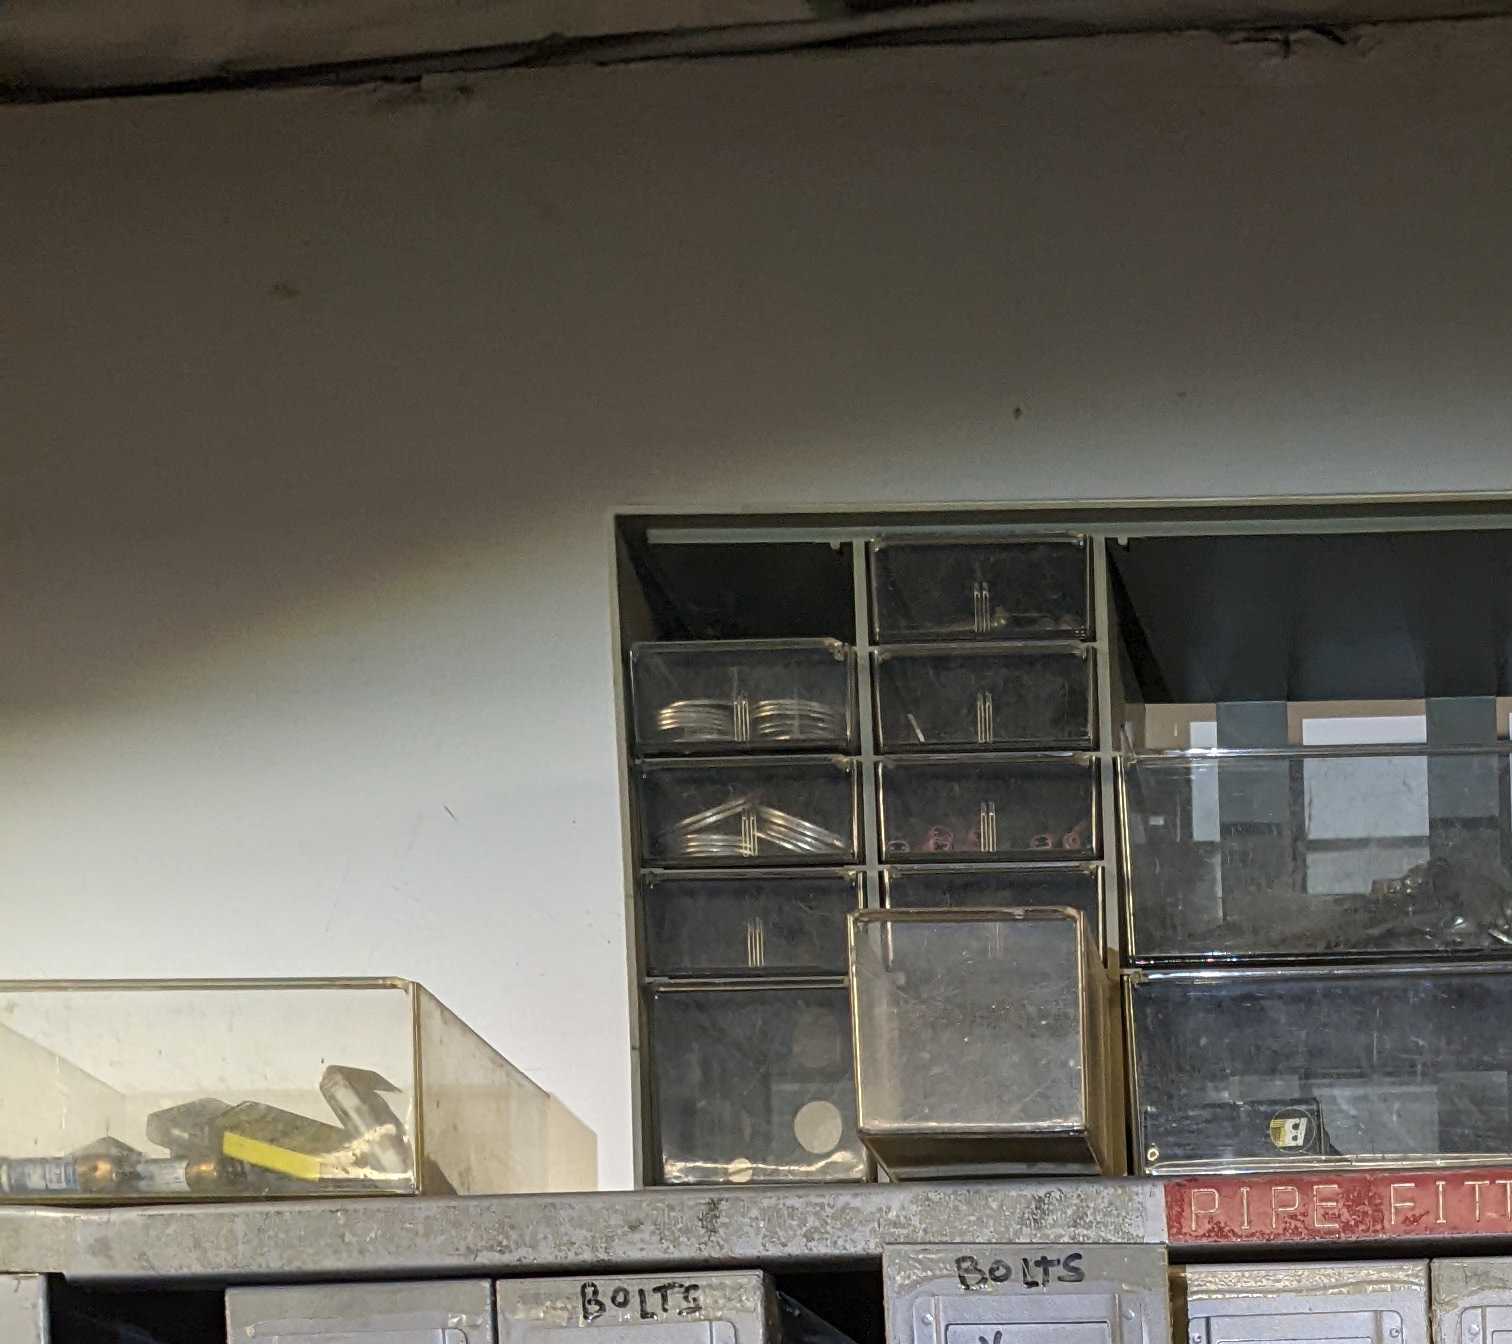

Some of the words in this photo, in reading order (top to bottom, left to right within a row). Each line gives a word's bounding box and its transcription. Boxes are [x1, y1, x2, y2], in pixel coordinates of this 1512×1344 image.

[1191, 1185, 1339, 1230] PIPE
[954, 1254, 1086, 1289] BOLTS
[581, 1282, 699, 1320] BOLTS
